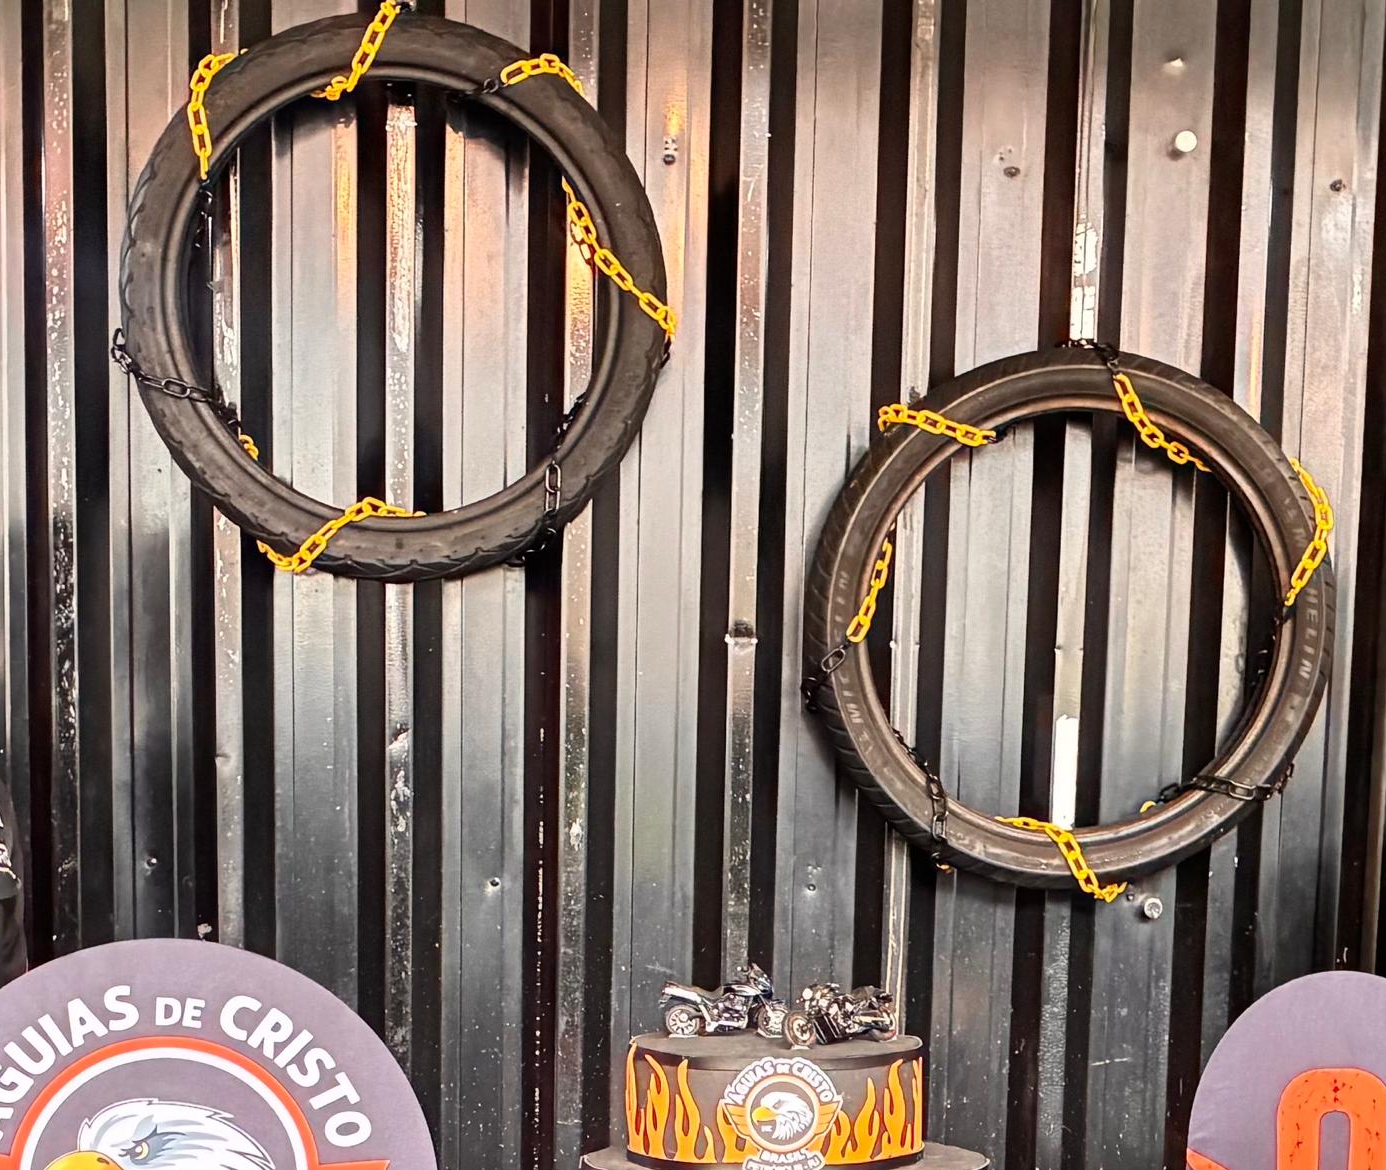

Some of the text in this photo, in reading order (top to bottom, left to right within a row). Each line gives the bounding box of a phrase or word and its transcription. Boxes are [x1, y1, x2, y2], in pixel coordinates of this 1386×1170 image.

[155, 997, 205, 1028] DE
[219, 995, 373, 1148] CRISTO
[793, 1061, 833, 1102] CRISTO
